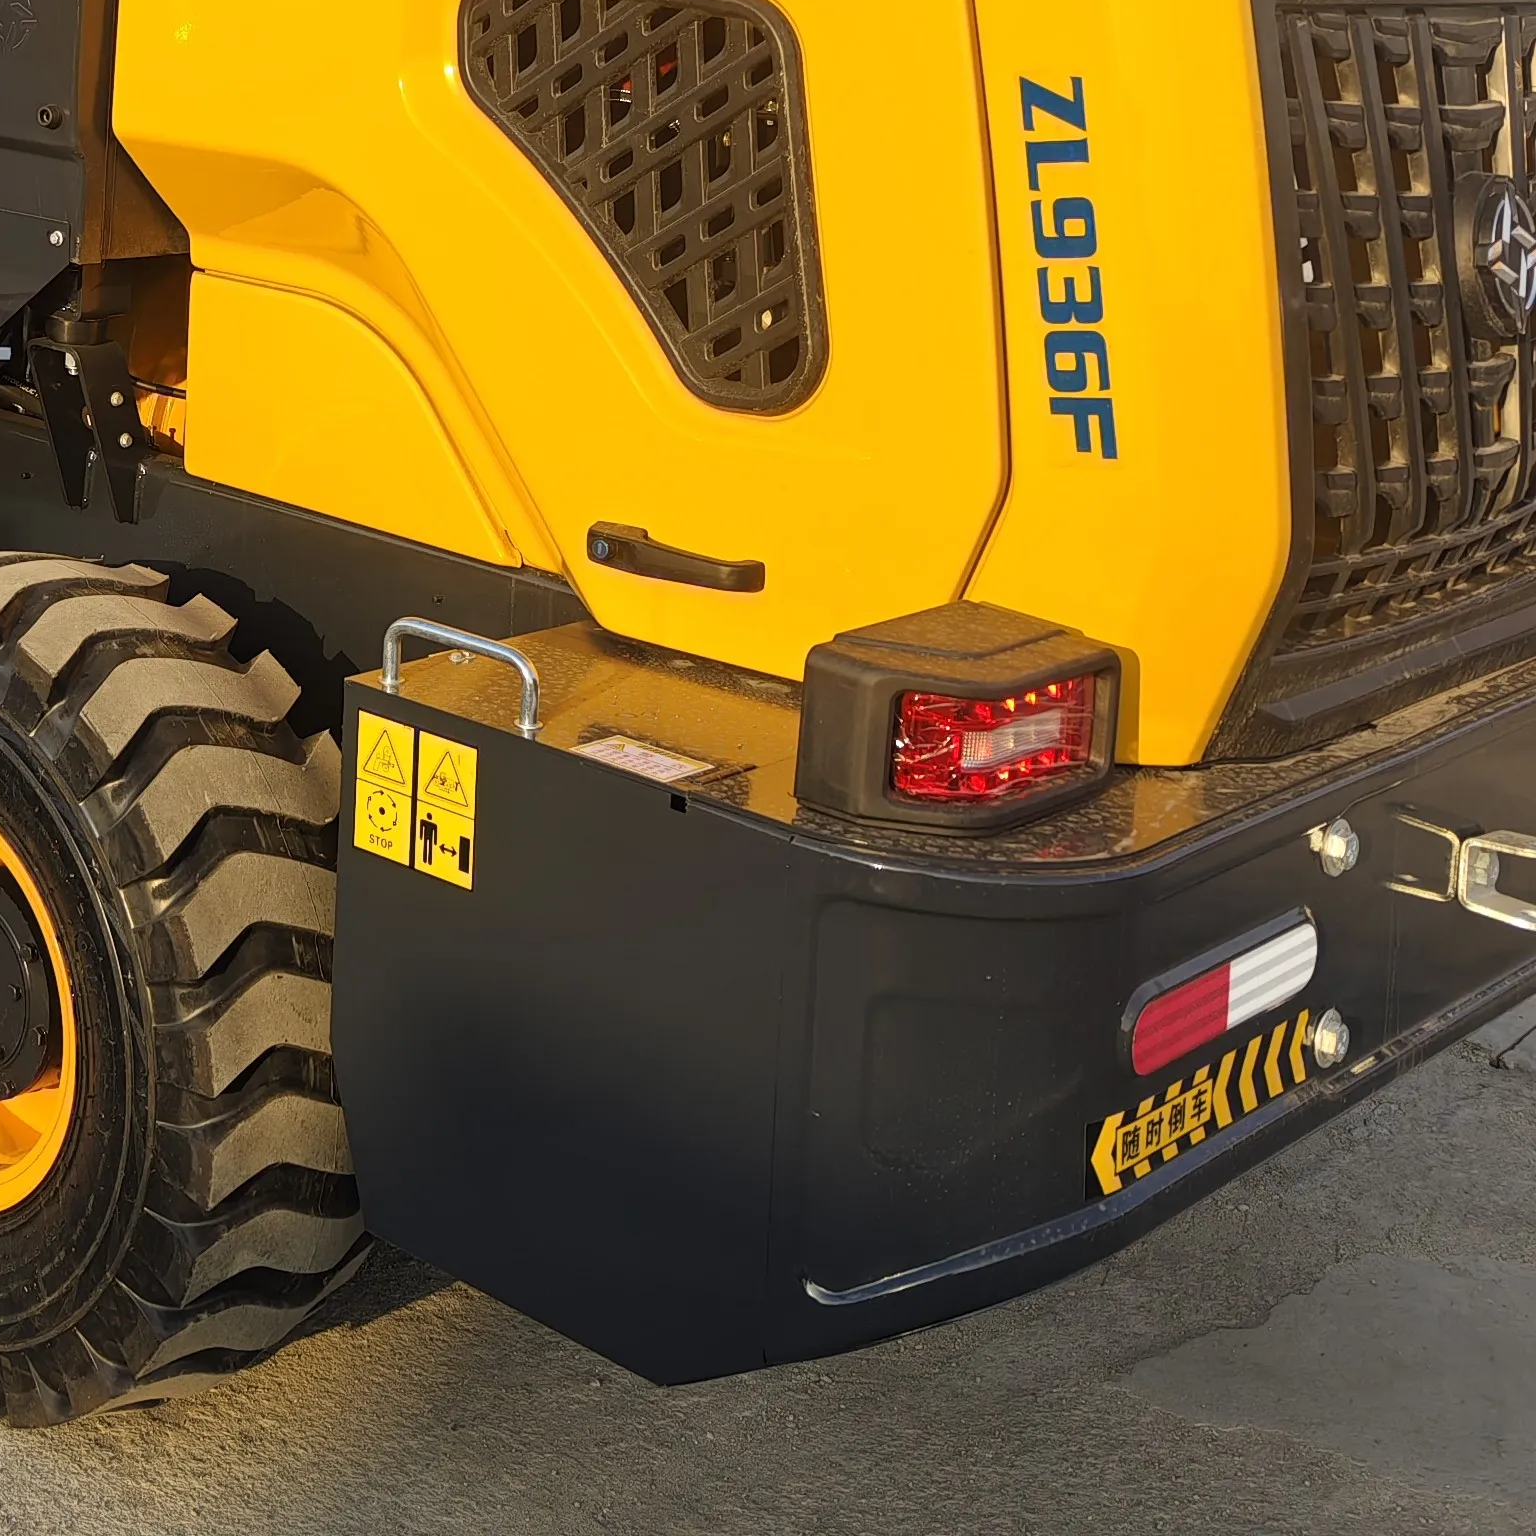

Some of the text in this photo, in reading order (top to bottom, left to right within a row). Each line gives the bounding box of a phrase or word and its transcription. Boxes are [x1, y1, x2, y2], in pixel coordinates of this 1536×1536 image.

[1018, 75, 1119, 460] ZL936F
[369, 834, 393, 850] STOP
[1121, 1088, 1209, 1166] 随时倒车
